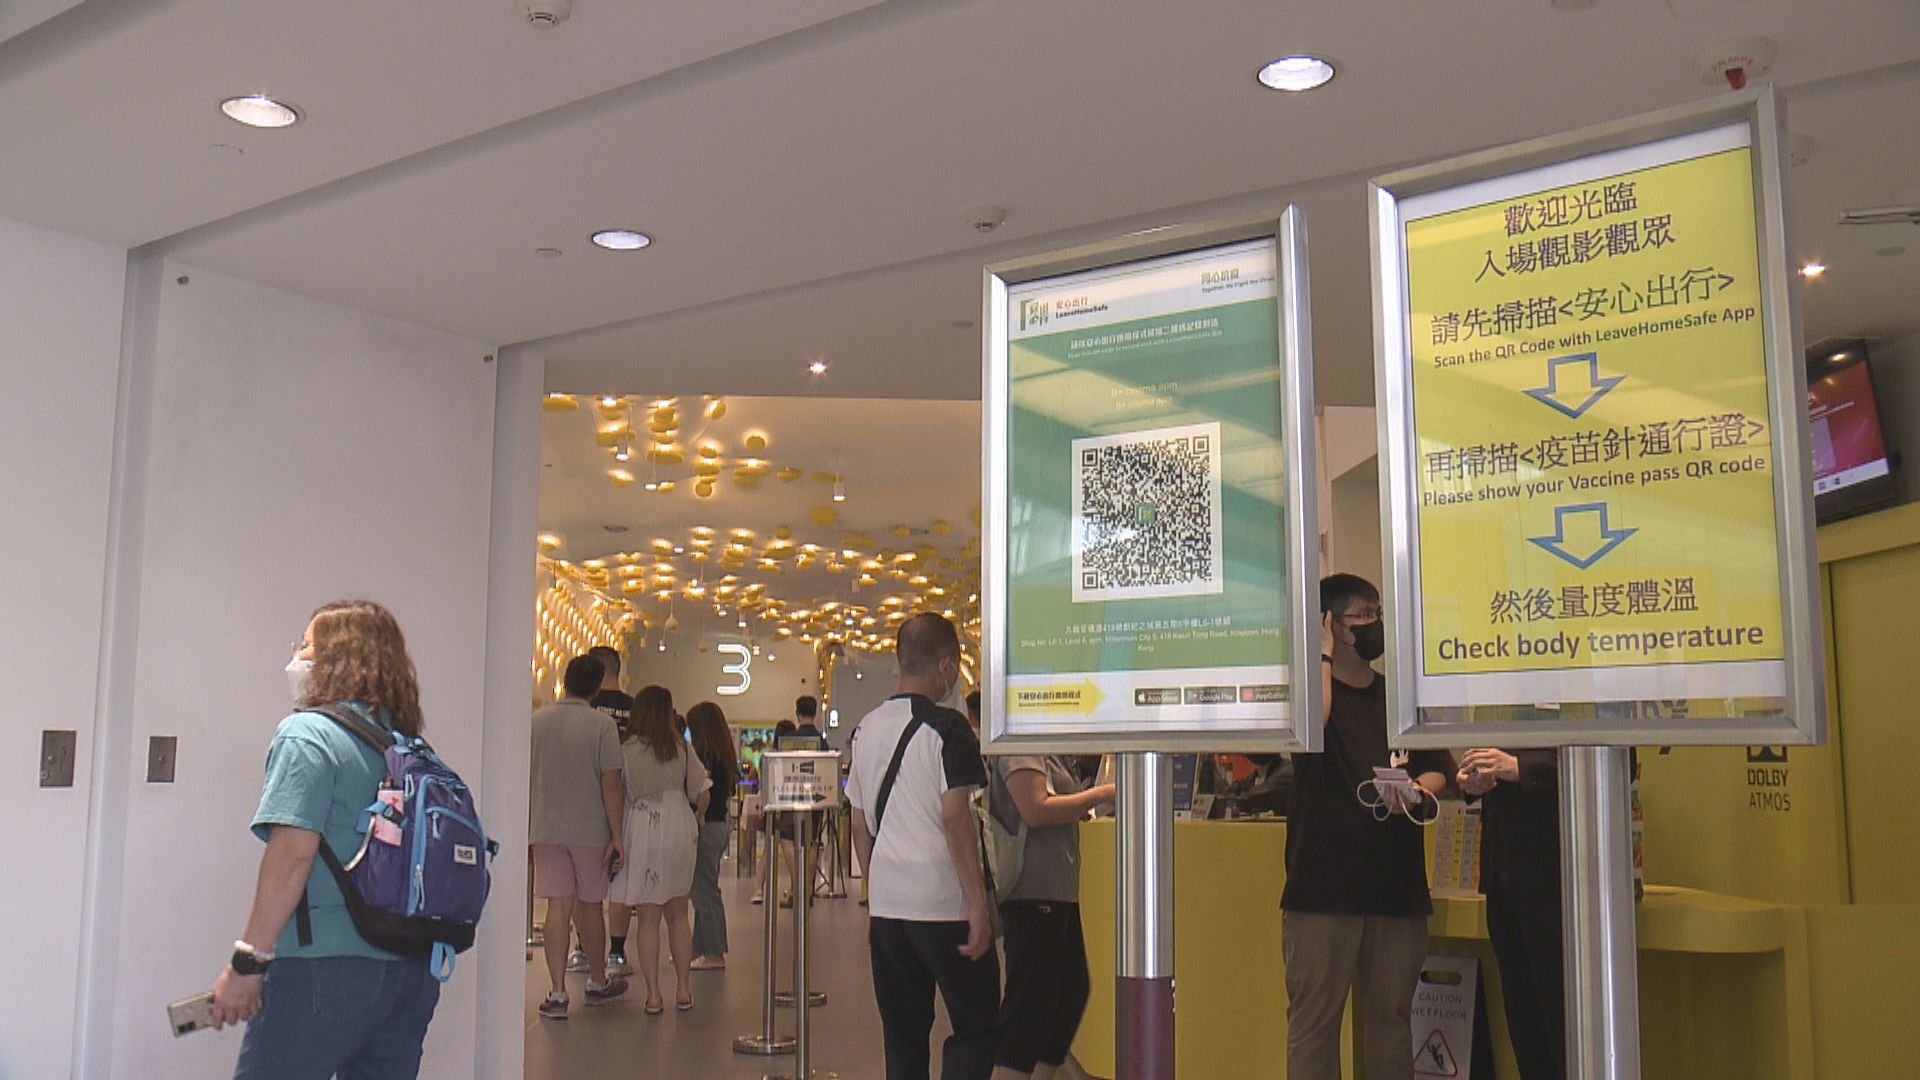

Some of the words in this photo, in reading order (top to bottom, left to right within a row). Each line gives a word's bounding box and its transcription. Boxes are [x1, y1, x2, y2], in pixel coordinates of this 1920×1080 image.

[1504, 182, 1638, 238] 歡迎光臨
[1475, 214, 1676, 283] 入場觀影觀眾
[1055, 304, 1108, 319] LeaveHomeSafe
[1431, 266, 1735, 346] 請先掃描<安心出行>
[1434, 353, 1466, 369] Scan
[1469, 347, 1491, 363] the
[1495, 344, 1516, 361] QR
[1520, 337, 1555, 355] Code
[1560, 331, 1591, 349] with
[1596, 312, 1718, 344] LeaveHomeSafe
[1722, 305, 1755, 325] App
[1425, 413, 1765, 483] 再掃描<疫苗針通行證>
[1424, 490, 1473, 507] Please
[1478, 483, 1521, 501] show
[1526, 480, 1564, 499] your
[1568, 470, 1635, 490] Vaccine
[1641, 466, 1680, 485] pass
[1685, 459, 1714, 478] QR
[1719, 455, 1765, 474] code
[1490, 577, 1698, 625] 然後量度體溫
[1438, 636, 1510, 660] Check
[1518, 632, 1580, 659] body
[1587, 625, 1764, 655] temperature
[717, 643, 751, 695] 3
[1747, 769, 1788, 787] DOLBY
[1749, 792, 1791, 811] ATMOS
[1418, 991, 1462, 1004] CAUTION
